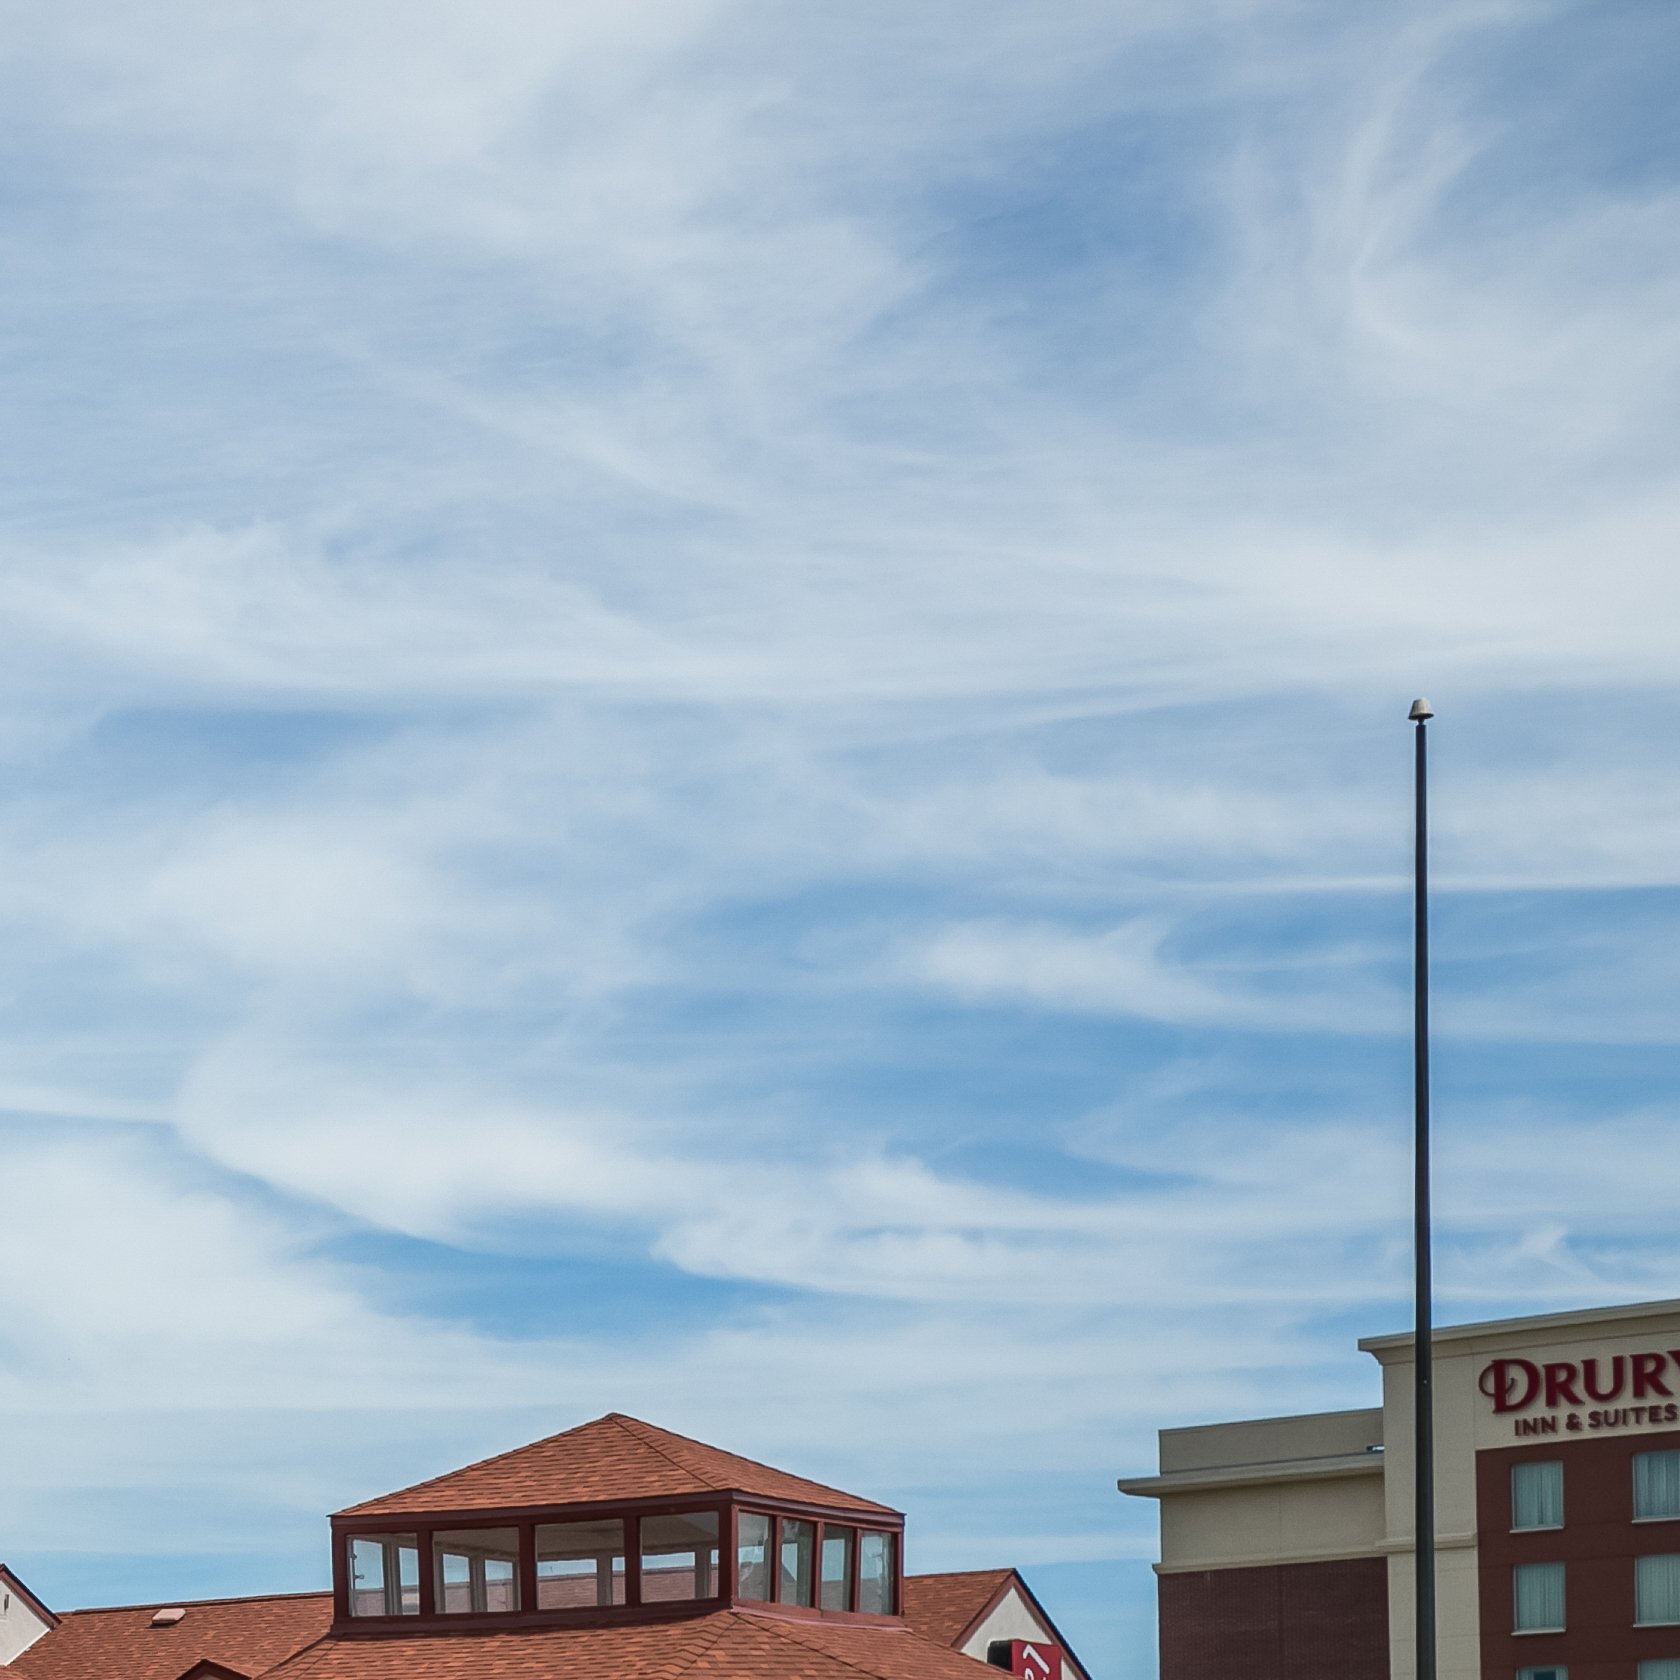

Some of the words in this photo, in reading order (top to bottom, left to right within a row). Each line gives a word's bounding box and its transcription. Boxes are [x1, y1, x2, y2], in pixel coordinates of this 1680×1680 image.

[1514, 1416, 1557, 1436] INN
[1566, 1412, 1582, 1431] &
[1587, 1403, 1678, 1429] SUITES
